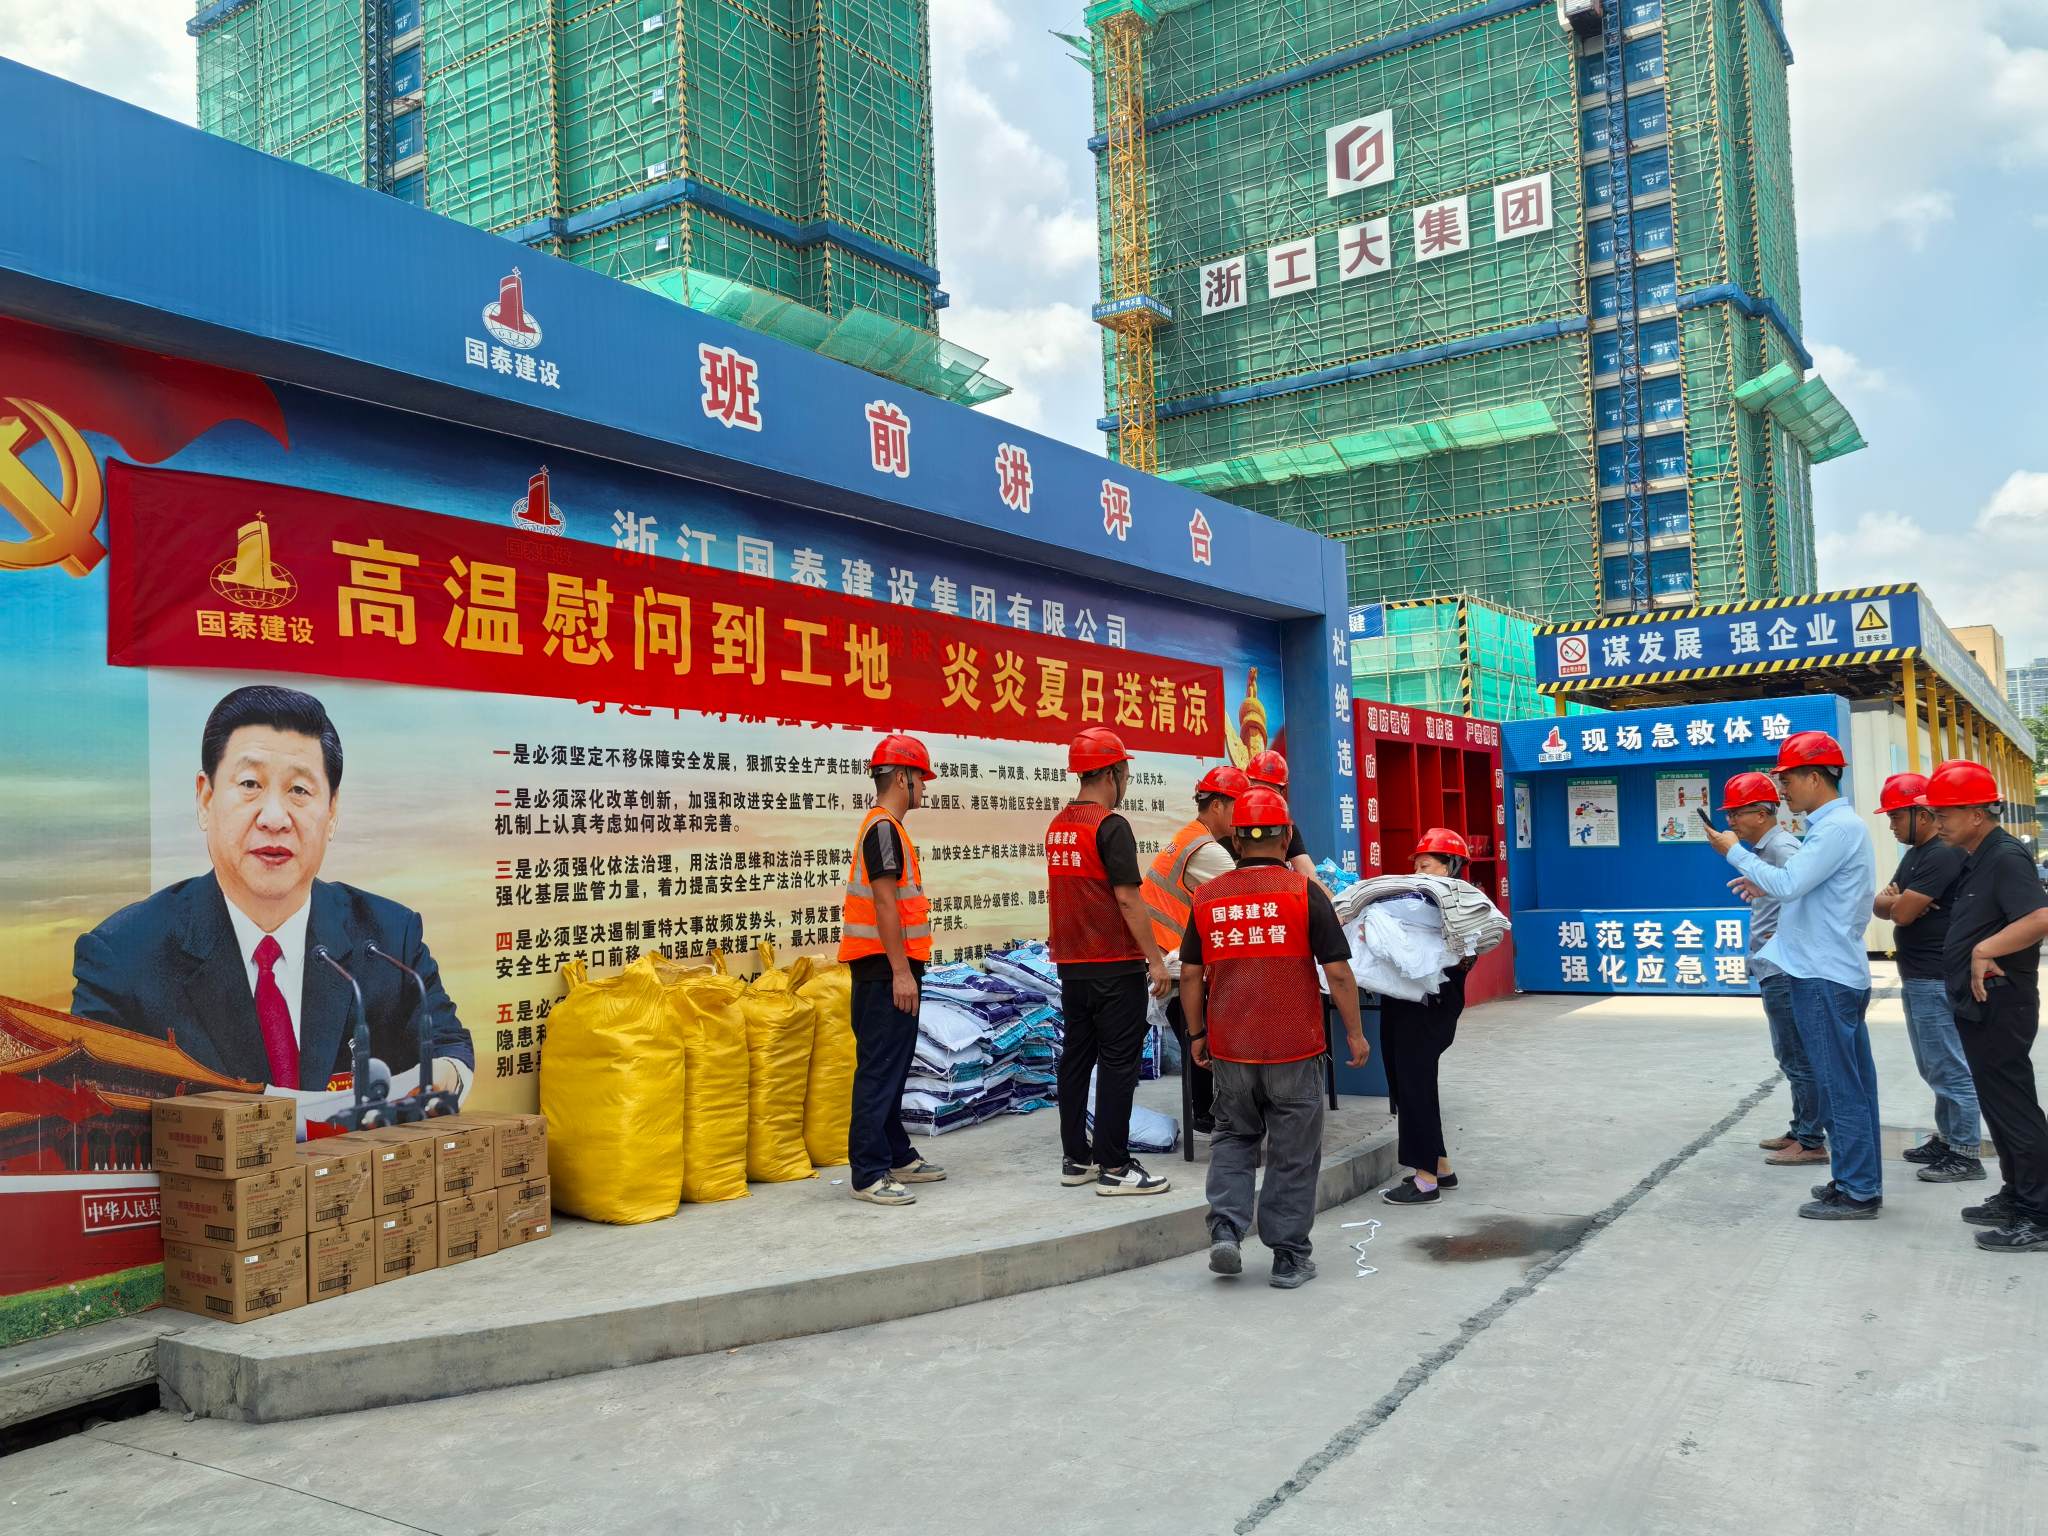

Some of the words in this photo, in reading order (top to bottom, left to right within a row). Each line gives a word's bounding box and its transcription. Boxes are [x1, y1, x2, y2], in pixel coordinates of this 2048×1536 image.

[1205, 183, 1543, 307] 浙工大集团
[465, 336, 560, 389] 国泰建设
[698, 342, 1213, 565] 班前讲评台
[611, 509, 1126, 649] 浙江国泰建设集团有限公司
[196, 609, 315, 645] 国泰建设
[332, 538, 892, 700] 高温慰问到工地
[941, 641, 1209, 736] 炎炎夏日送清凉
[1602, 627, 1703, 667] 谋发展
[1729, 613, 1838, 655] 强企业
[1581, 713, 1792, 753] 现场急救体验
[494, 813, 740, 836] 机制上认真考虑如何改革和完善。
[1047, 850, 1082, 868] 全监督
[495, 904, 845, 952] 四是必须坚决遏制重特大事故频发势头，对易发重
[1211, 901, 1280, 925] 国泰建设
[1209, 924, 1288, 950] 安全监督
[1558, 919, 1744, 950] 规范安全用
[1560, 955, 1750, 985] 强化应急理
